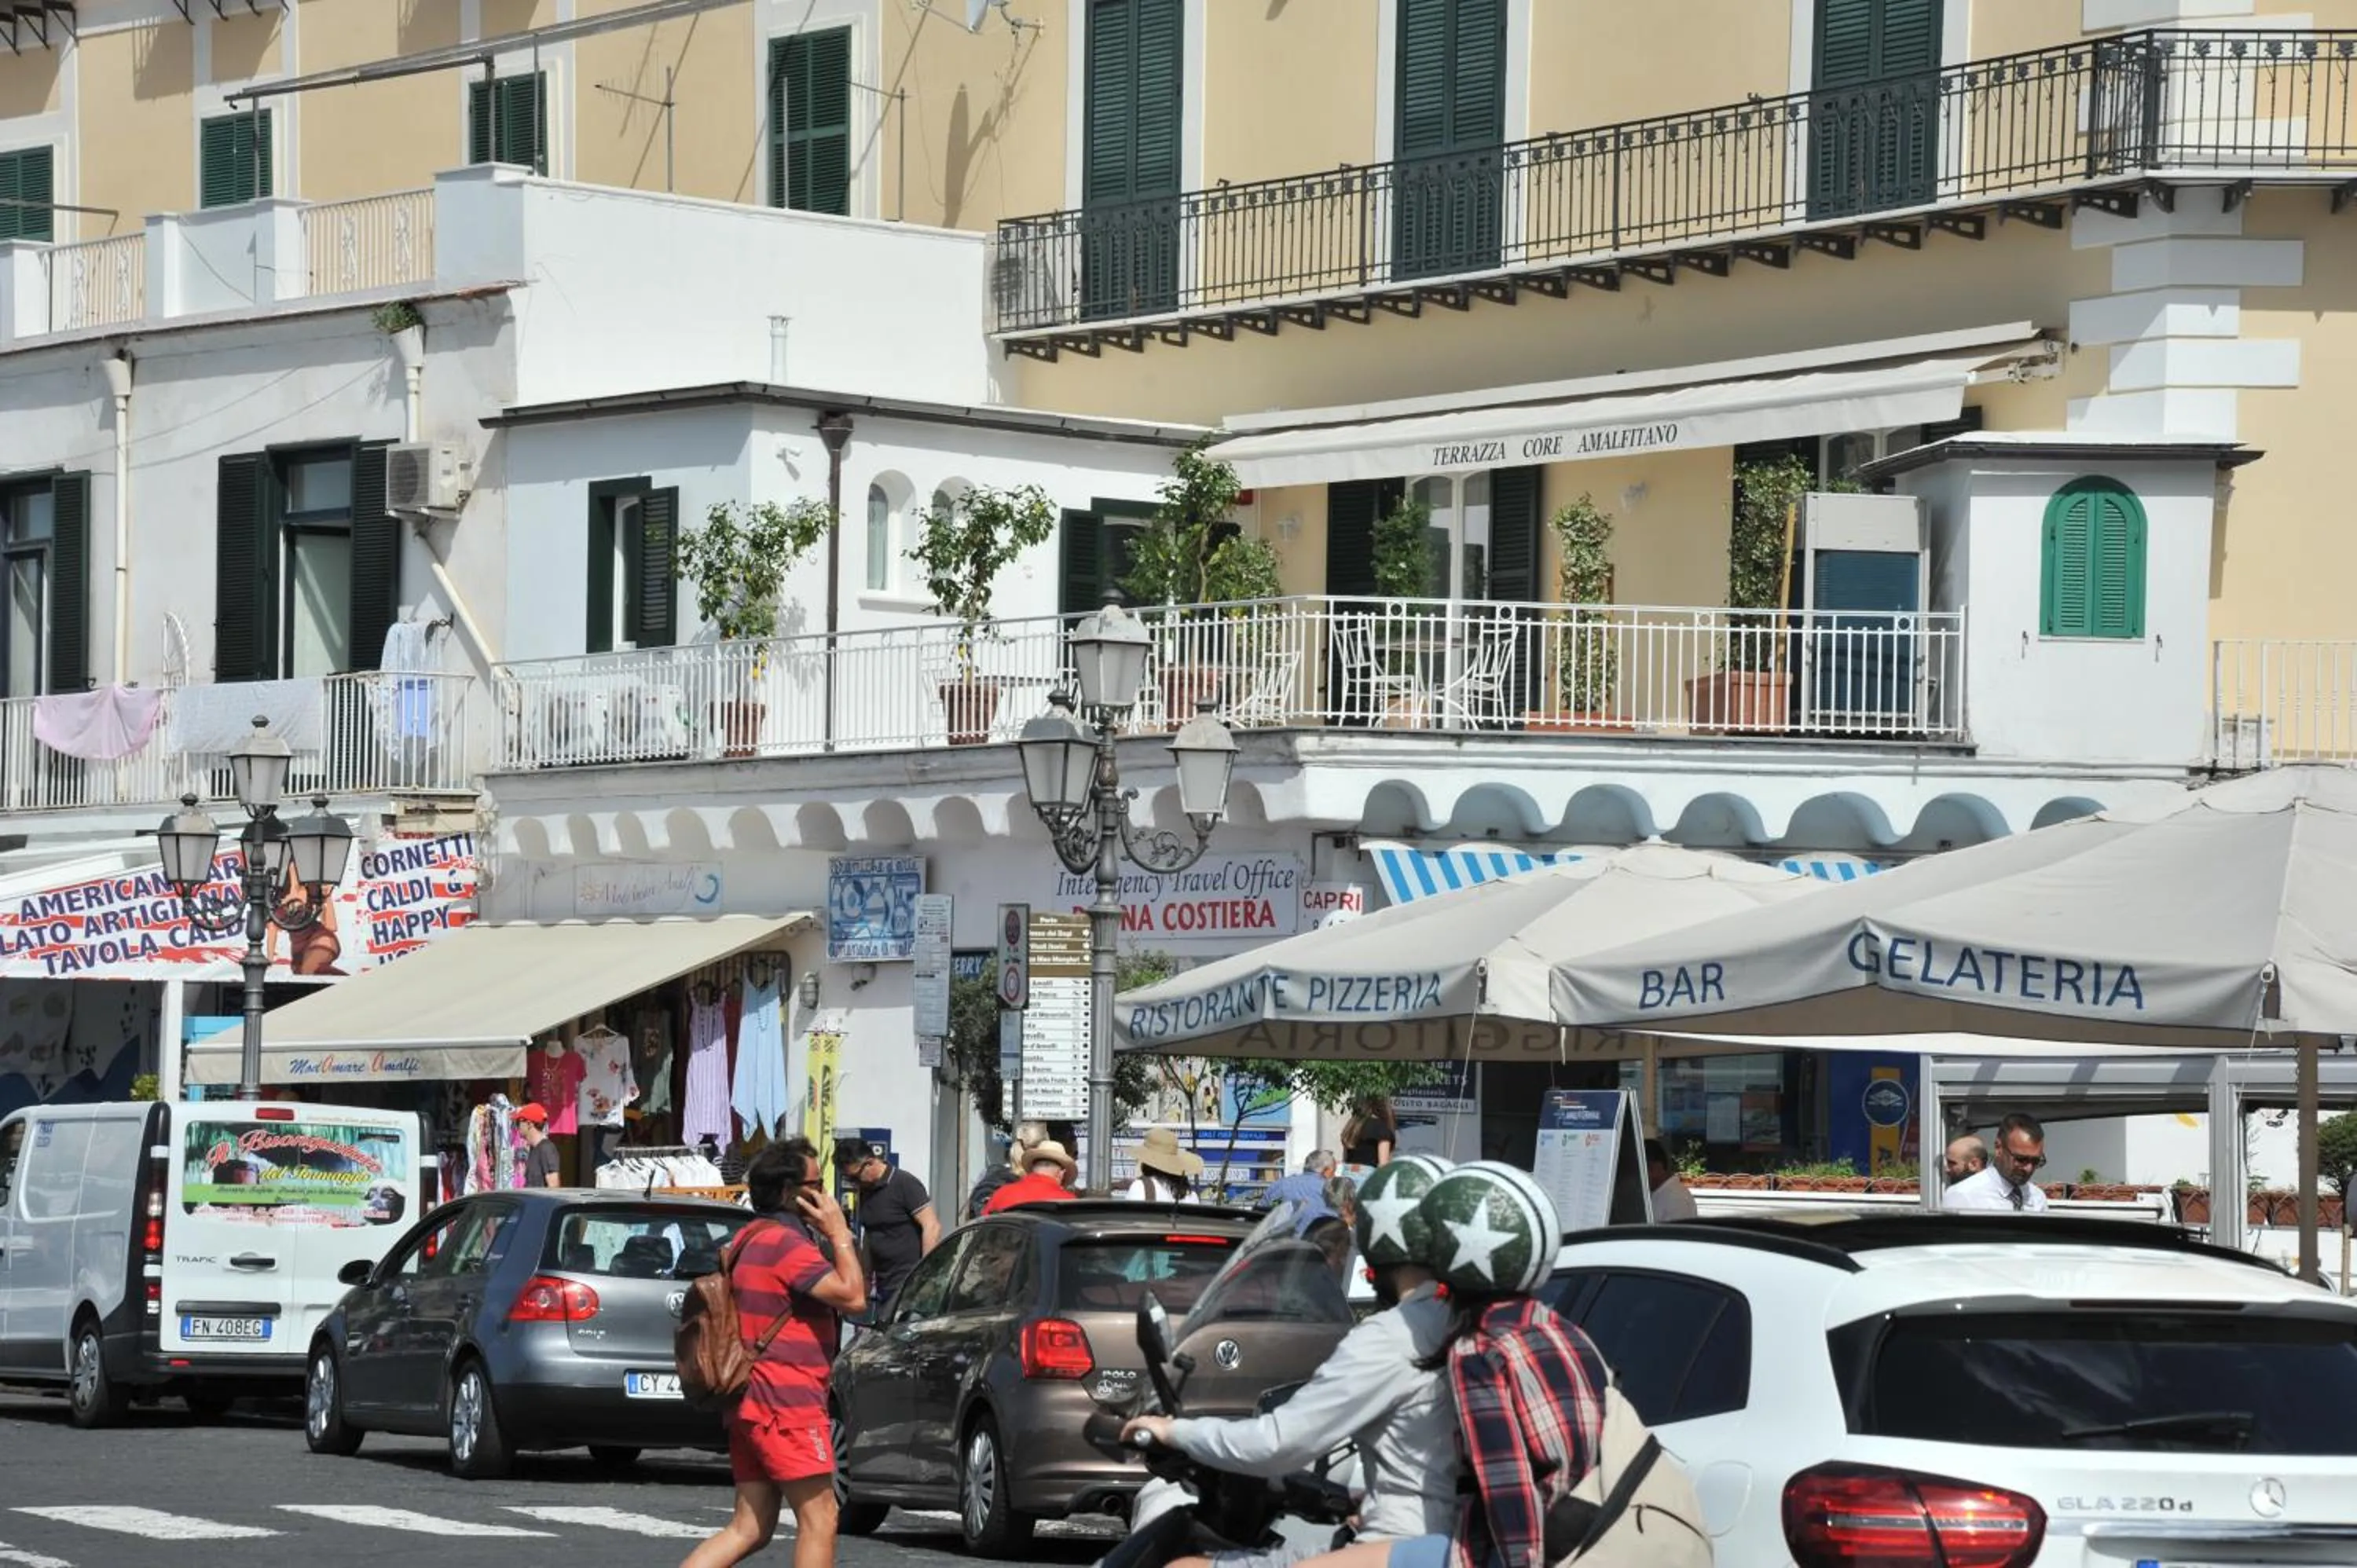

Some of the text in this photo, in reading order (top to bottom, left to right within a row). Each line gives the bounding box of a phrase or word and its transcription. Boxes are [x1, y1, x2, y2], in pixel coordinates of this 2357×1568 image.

[1432, 423, 1679, 466] TERRAZZA CORE AMALFITANO
[361, 832, 475, 879] CORNETTI
[20, 873, 175, 923] AMERICAN
[367, 876, 434, 911] CALDI
[1055, 870, 1164, 903] Integency
[1233, 859, 1296, 899] Office
[1303, 890, 1361, 911] CAPRI
[83, 885, 245, 940] ARTIGIANA
[372, 904, 450, 945] HAPPY
[1161, 899, 1277, 932] COSTIERA
[40, 918, 244, 976] TAVOLA CALD
[954, 956, 983, 975] ERRY
[1638, 931, 2145, 1010] BAR GELATERIA
[1129, 973, 1442, 1040] RISTORANTE PIZZERIA
[192, 1319, 211, 1334] FN
[1102, 1369, 1137, 1379] POLO
[2057, 1497, 2115, 1511] GLA
